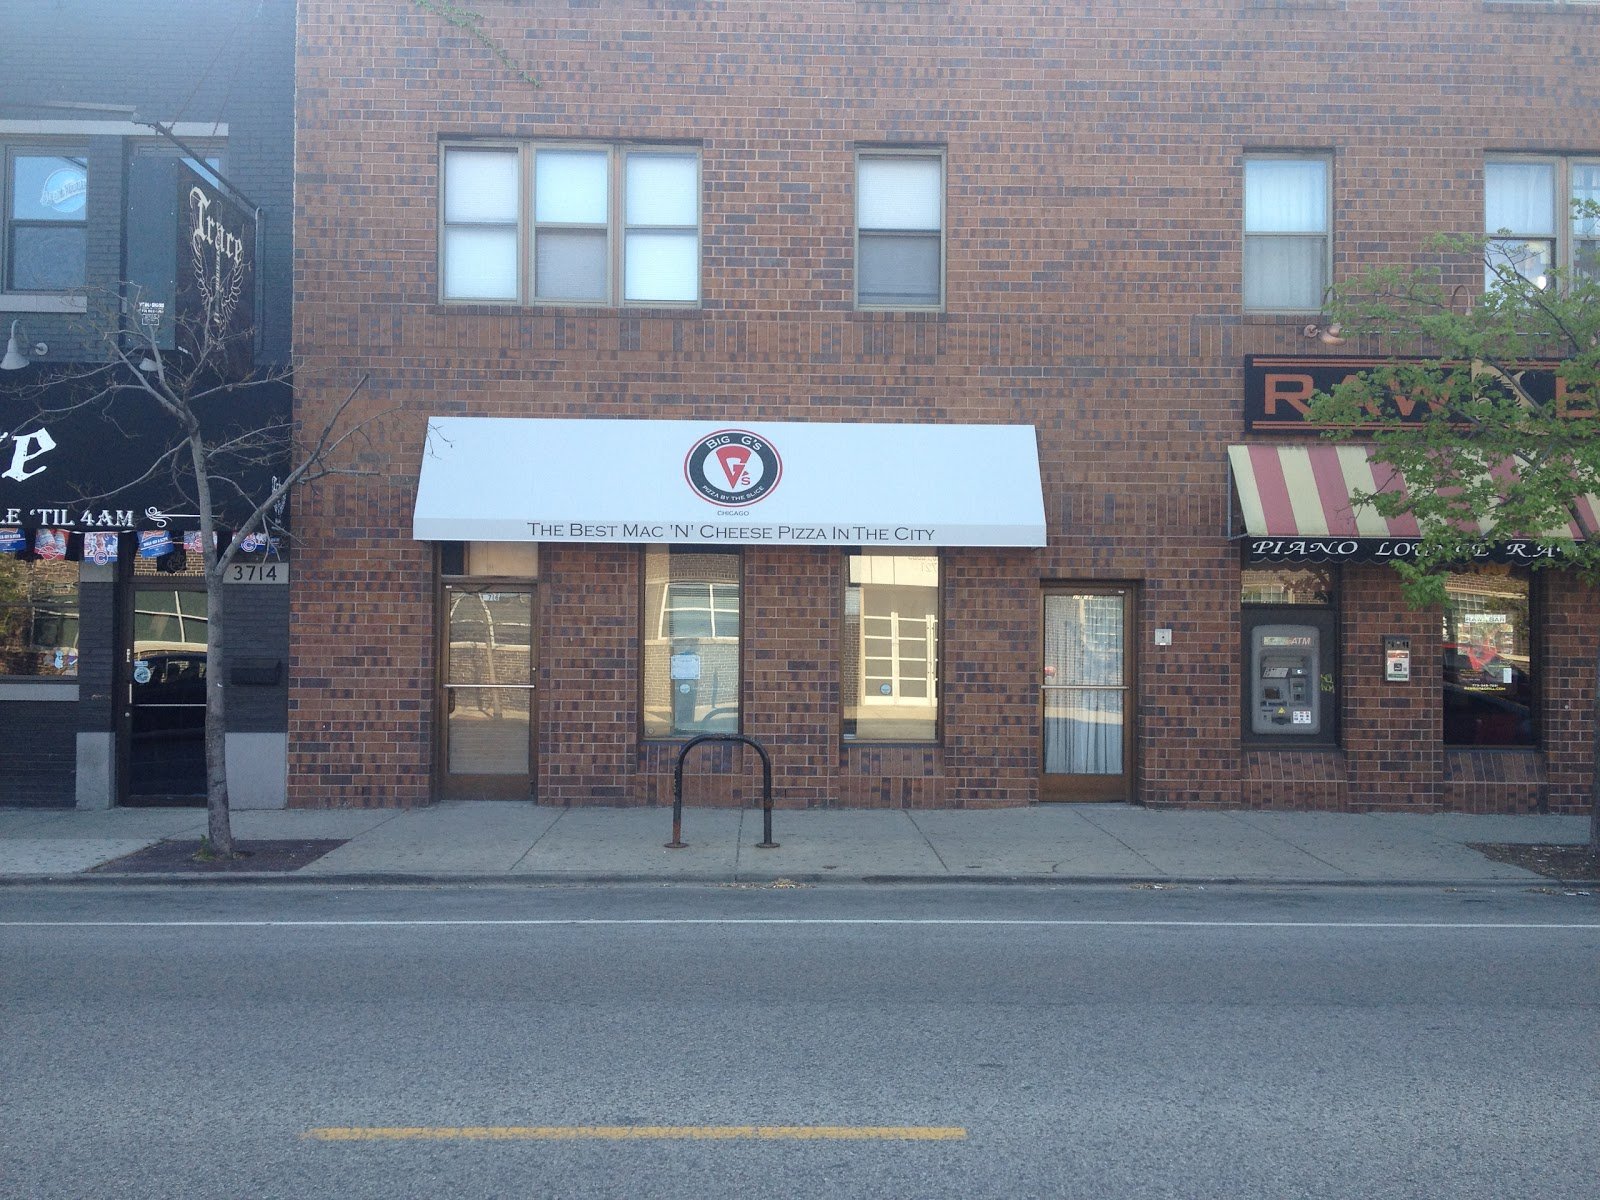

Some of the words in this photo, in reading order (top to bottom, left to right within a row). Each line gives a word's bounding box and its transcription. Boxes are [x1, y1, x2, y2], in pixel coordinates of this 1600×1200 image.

[190, 187, 243, 265] Trace
[706, 436, 731, 450] BIG
[702, 485, 719, 499] PIZZA
[746, 486, 764, 499] SLICE
[80, 509, 135, 527] 4AM
[527, 522, 564, 537] THE
[570, 523, 618, 537] BEST
[623, 524, 664, 538] MAC
[670, 524, 694, 538] 'N'
[700, 524, 773, 539] CHEESE
[778, 525, 827, 540] PIZZA
[832, 526, 849, 540] IN
[853, 526, 889, 541] THE
[894, 526, 935, 541] CITY
[1252, 541, 1359, 555] PIANO
[1506, 543, 1590, 558] RA
[233, 565, 277, 581] 3714
[1291, 637, 1311, 645] ATM
